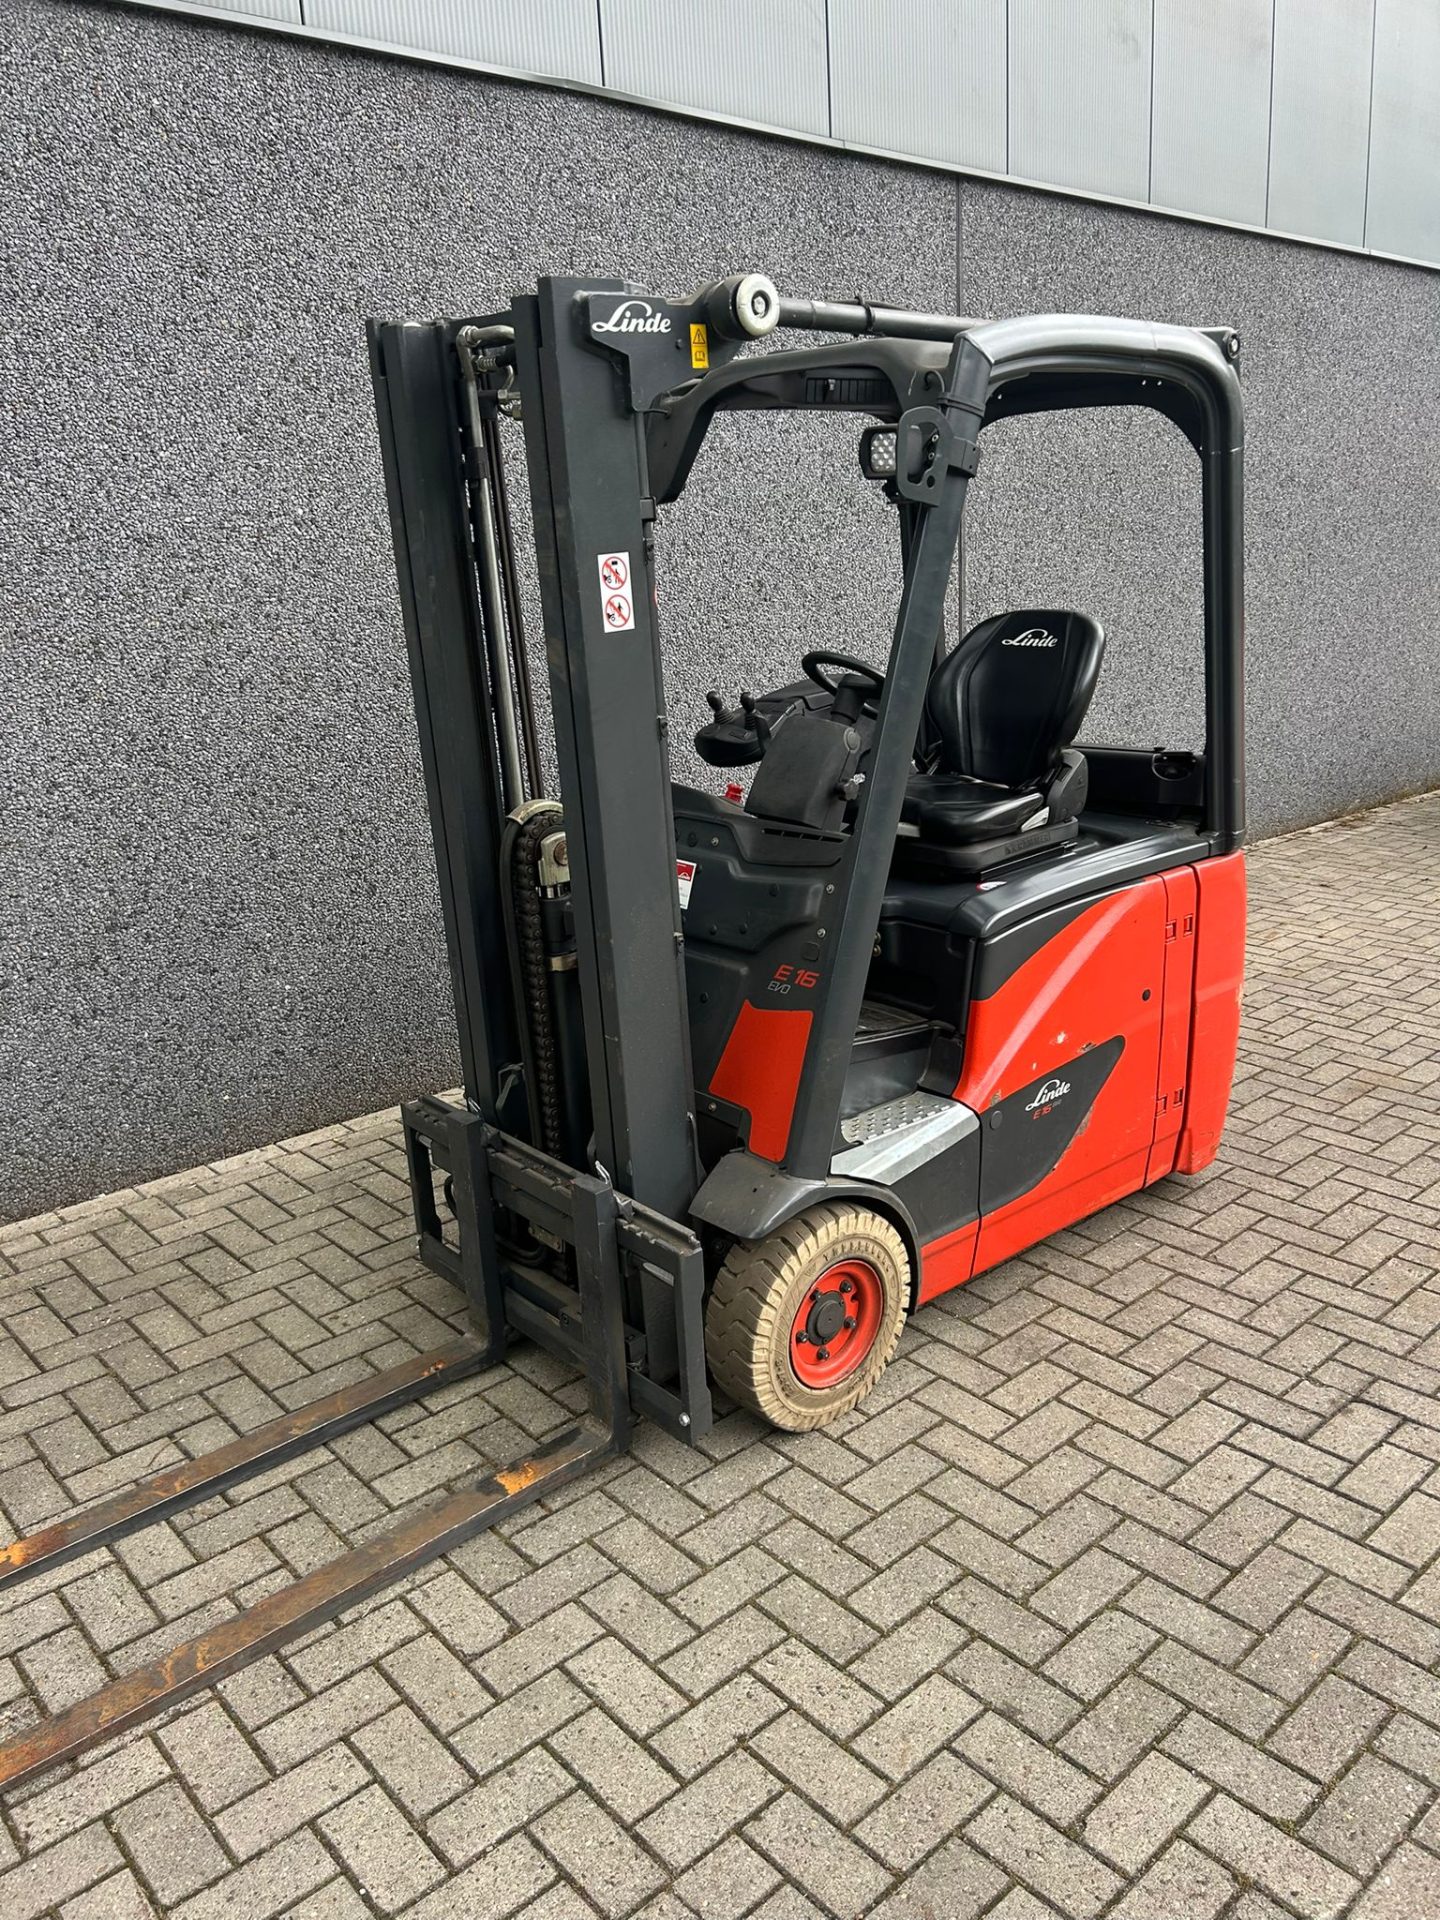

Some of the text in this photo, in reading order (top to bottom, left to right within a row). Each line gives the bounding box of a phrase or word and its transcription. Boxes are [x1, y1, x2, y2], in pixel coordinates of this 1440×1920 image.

[592, 300, 672, 333] Linde
[1001, 628, 1058, 649] Linde
[773, 963, 821, 989] E 16
[1025, 1079, 1071, 1111] Linde
